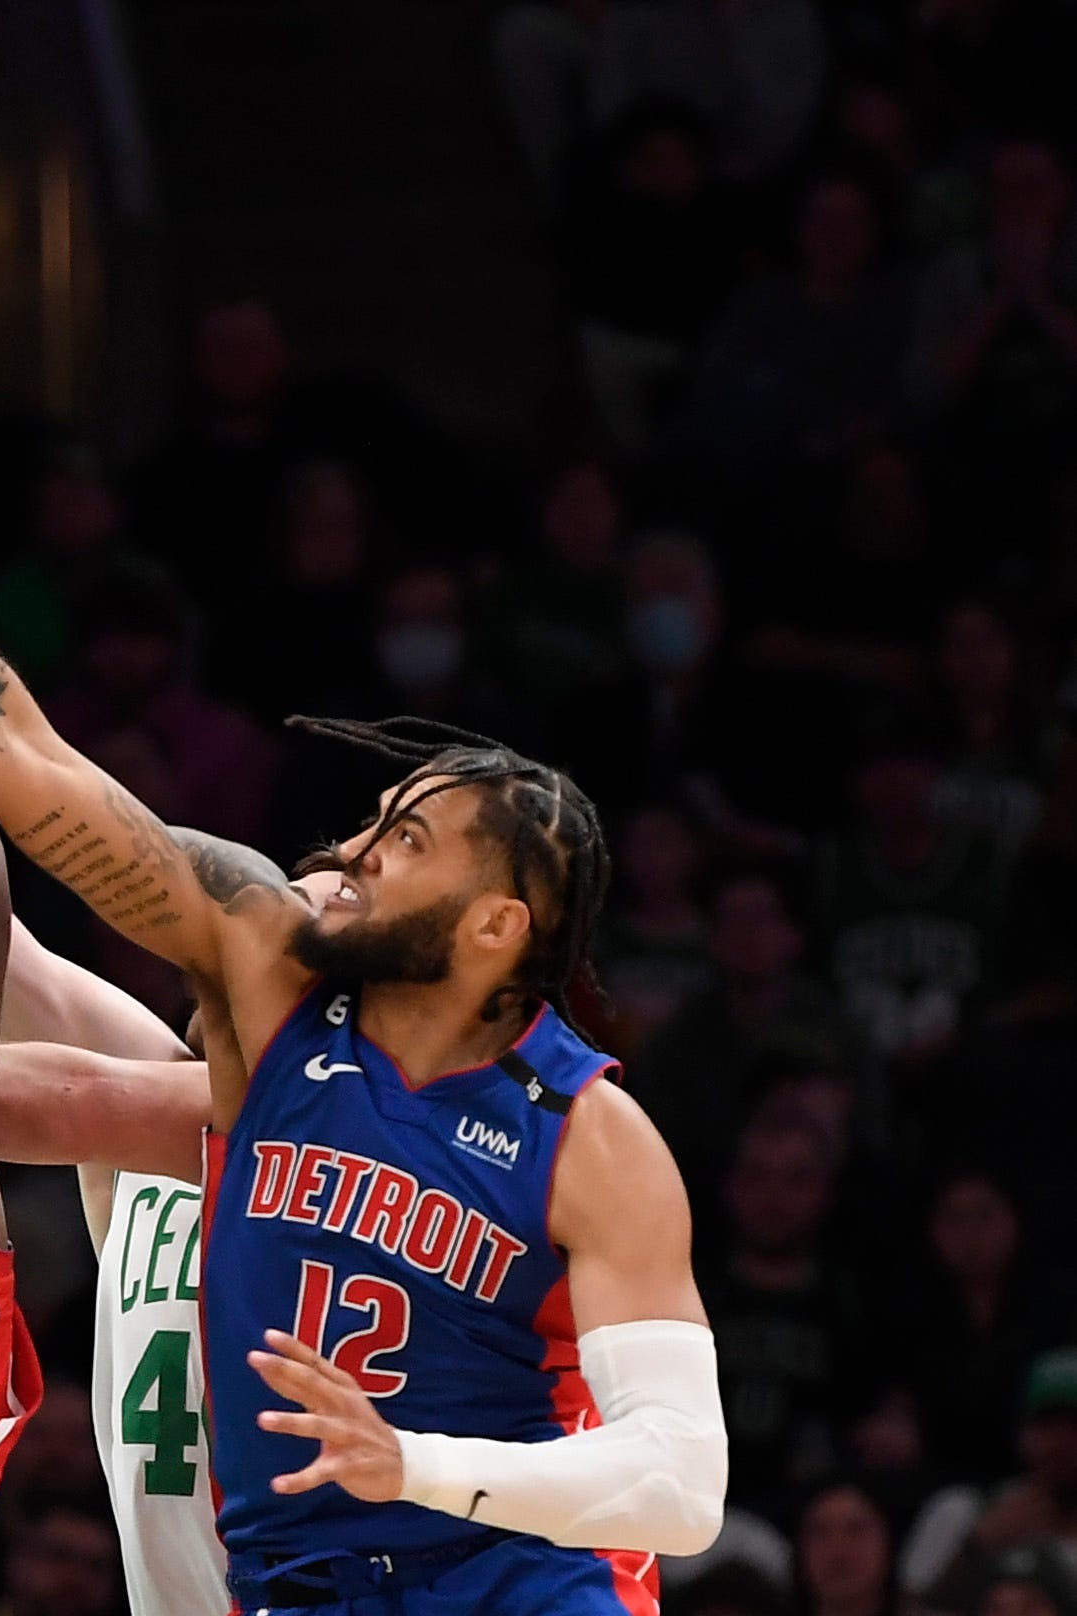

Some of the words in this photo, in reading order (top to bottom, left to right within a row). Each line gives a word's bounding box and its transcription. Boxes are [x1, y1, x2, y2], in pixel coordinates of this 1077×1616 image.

[325, 993, 352, 1026] 6
[455, 1115, 522, 1162] UWM
[120, 1185, 202, 1314] CEL
[245, 1140, 529, 1304] DETROIT
[291, 1257, 412, 1400] 12
[121, 1329, 200, 1497] 4
